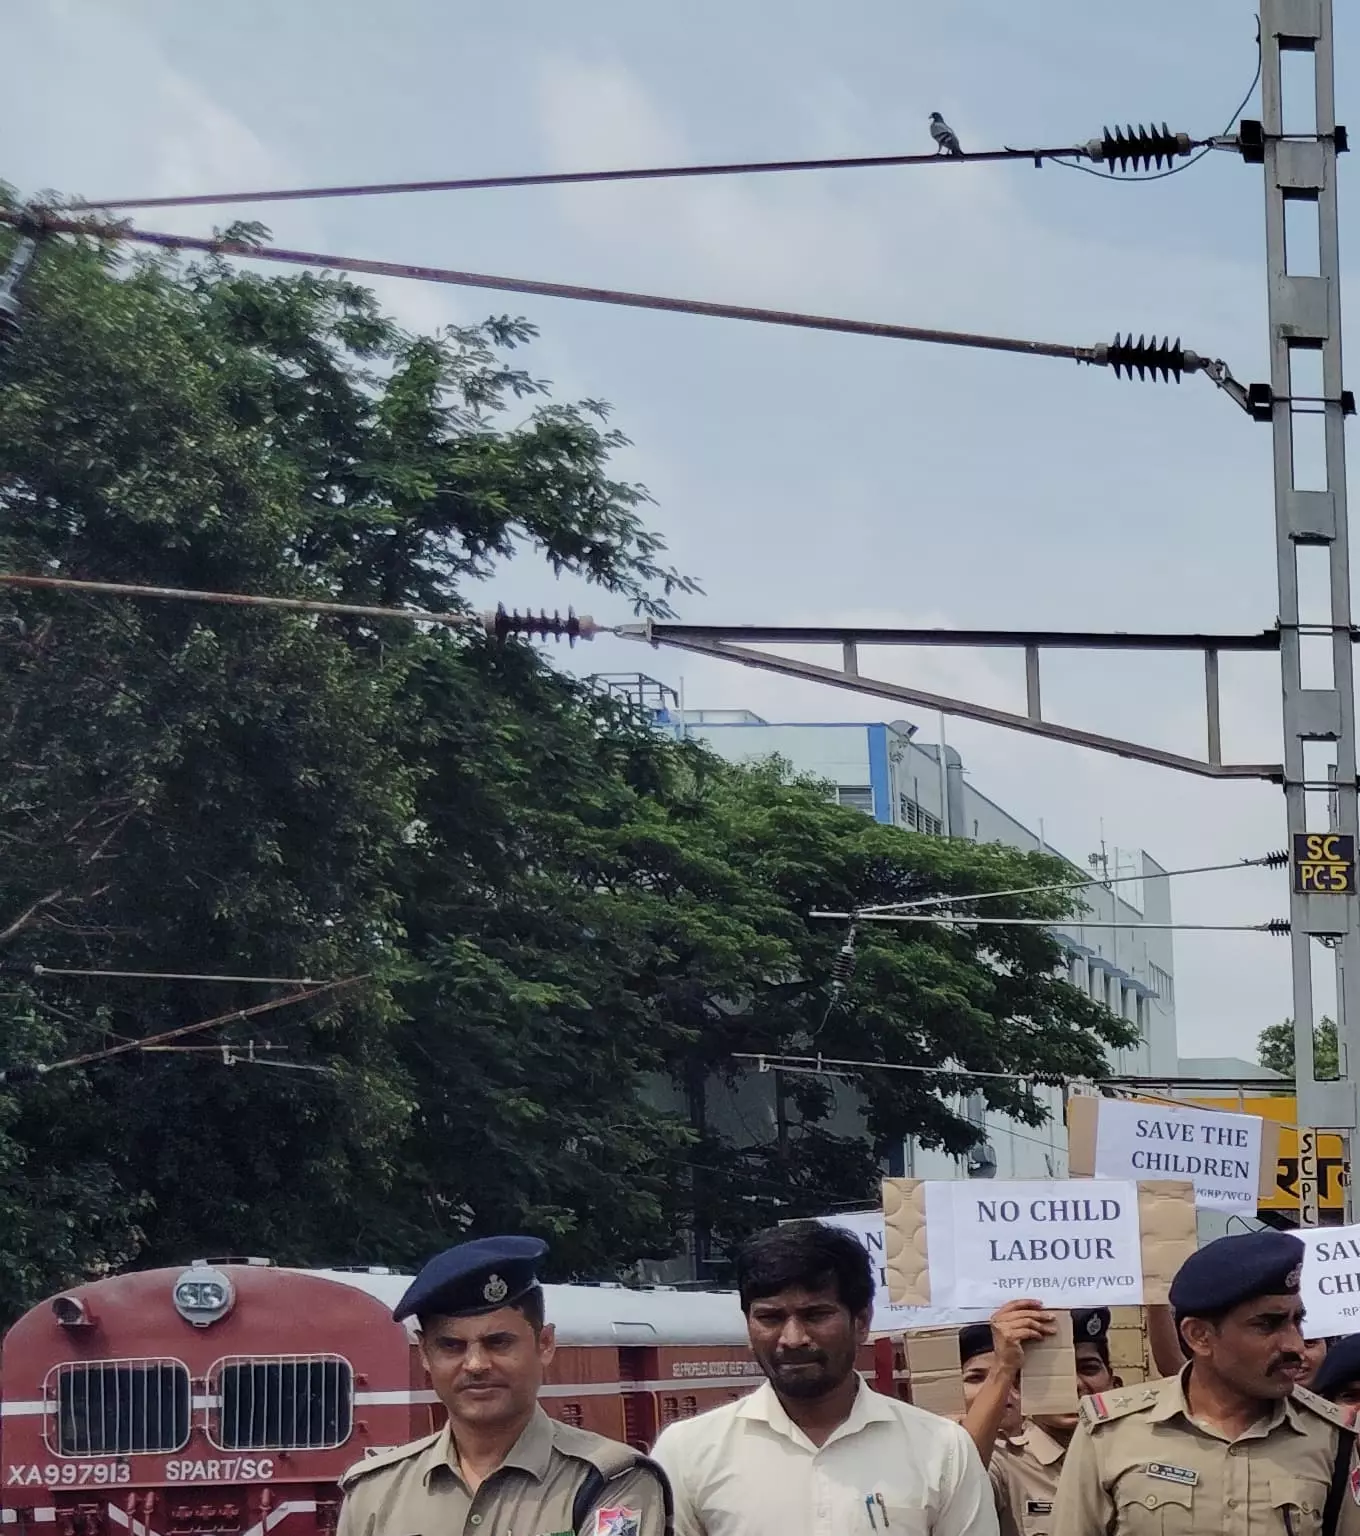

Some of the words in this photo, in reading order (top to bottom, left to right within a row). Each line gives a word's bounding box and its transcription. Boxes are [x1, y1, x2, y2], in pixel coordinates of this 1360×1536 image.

[1306, 835, 1341, 861] SC
[1301, 865, 1348, 891] PC-5
[1136, 1119, 1195, 1142] SAVE
[1200, 1126, 1249, 1147] THE
[1132, 1151, 1250, 1179] CHILDREN
[977, 1200, 1020, 1223] NO
[1030, 1199, 1121, 1222] CHILD
[989, 1238, 1116, 1262] LABOUR
[992, 1275, 1135, 1291] -RPF/BBA/GRP/WCD
[7, 1462, 131, 1486] XA997913
[165, 1456, 275, 1481] SPART/SC
